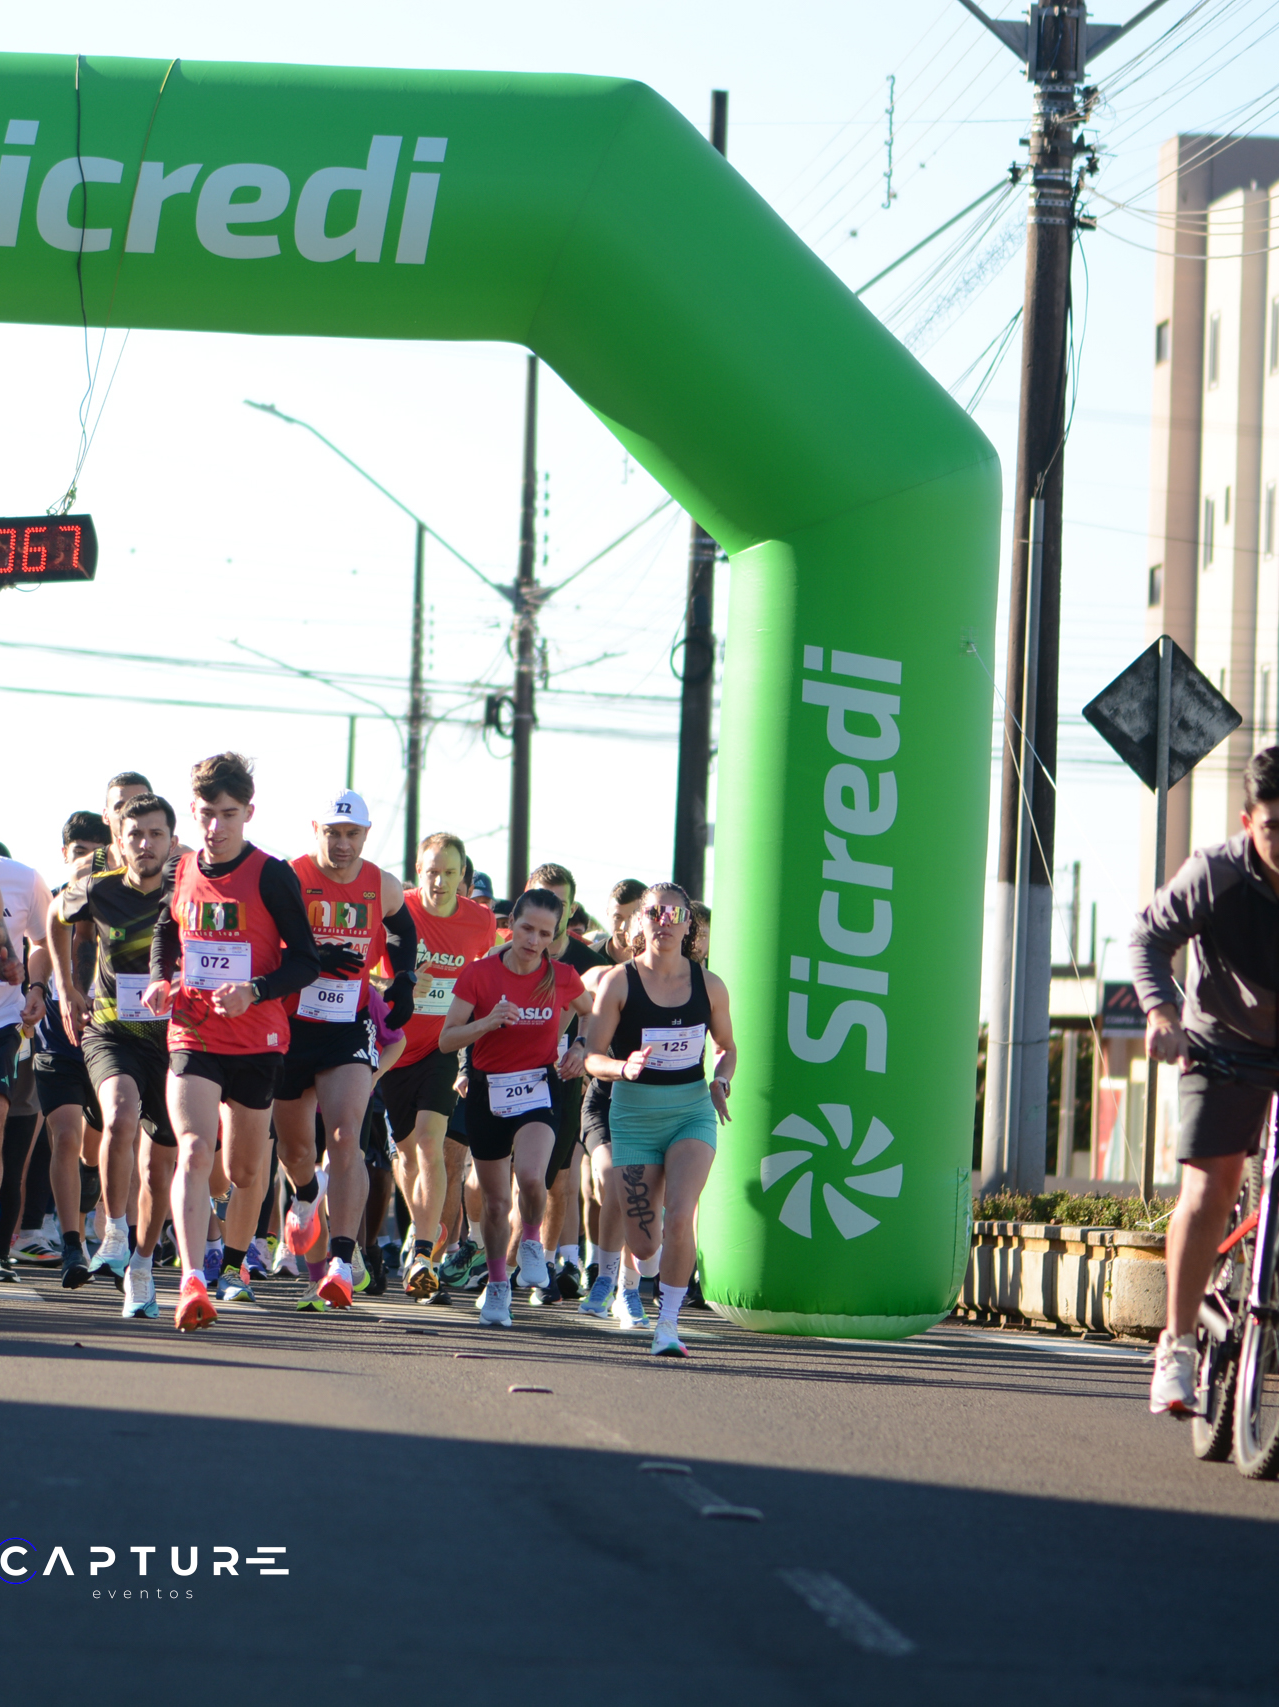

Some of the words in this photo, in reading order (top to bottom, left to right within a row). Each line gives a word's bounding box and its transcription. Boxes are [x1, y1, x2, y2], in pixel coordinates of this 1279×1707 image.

[787, 644, 902, 1074] Sicredi
[313, 927, 345, 935] running
[200, 955, 230, 969] 072
[317, 990, 345, 1003] 086
[428, 989, 445, 999] 40
[518, 1007, 553, 1020] ASLO
[661, 1040, 689, 1052] 125
[505, 1084, 532, 1098] 201
